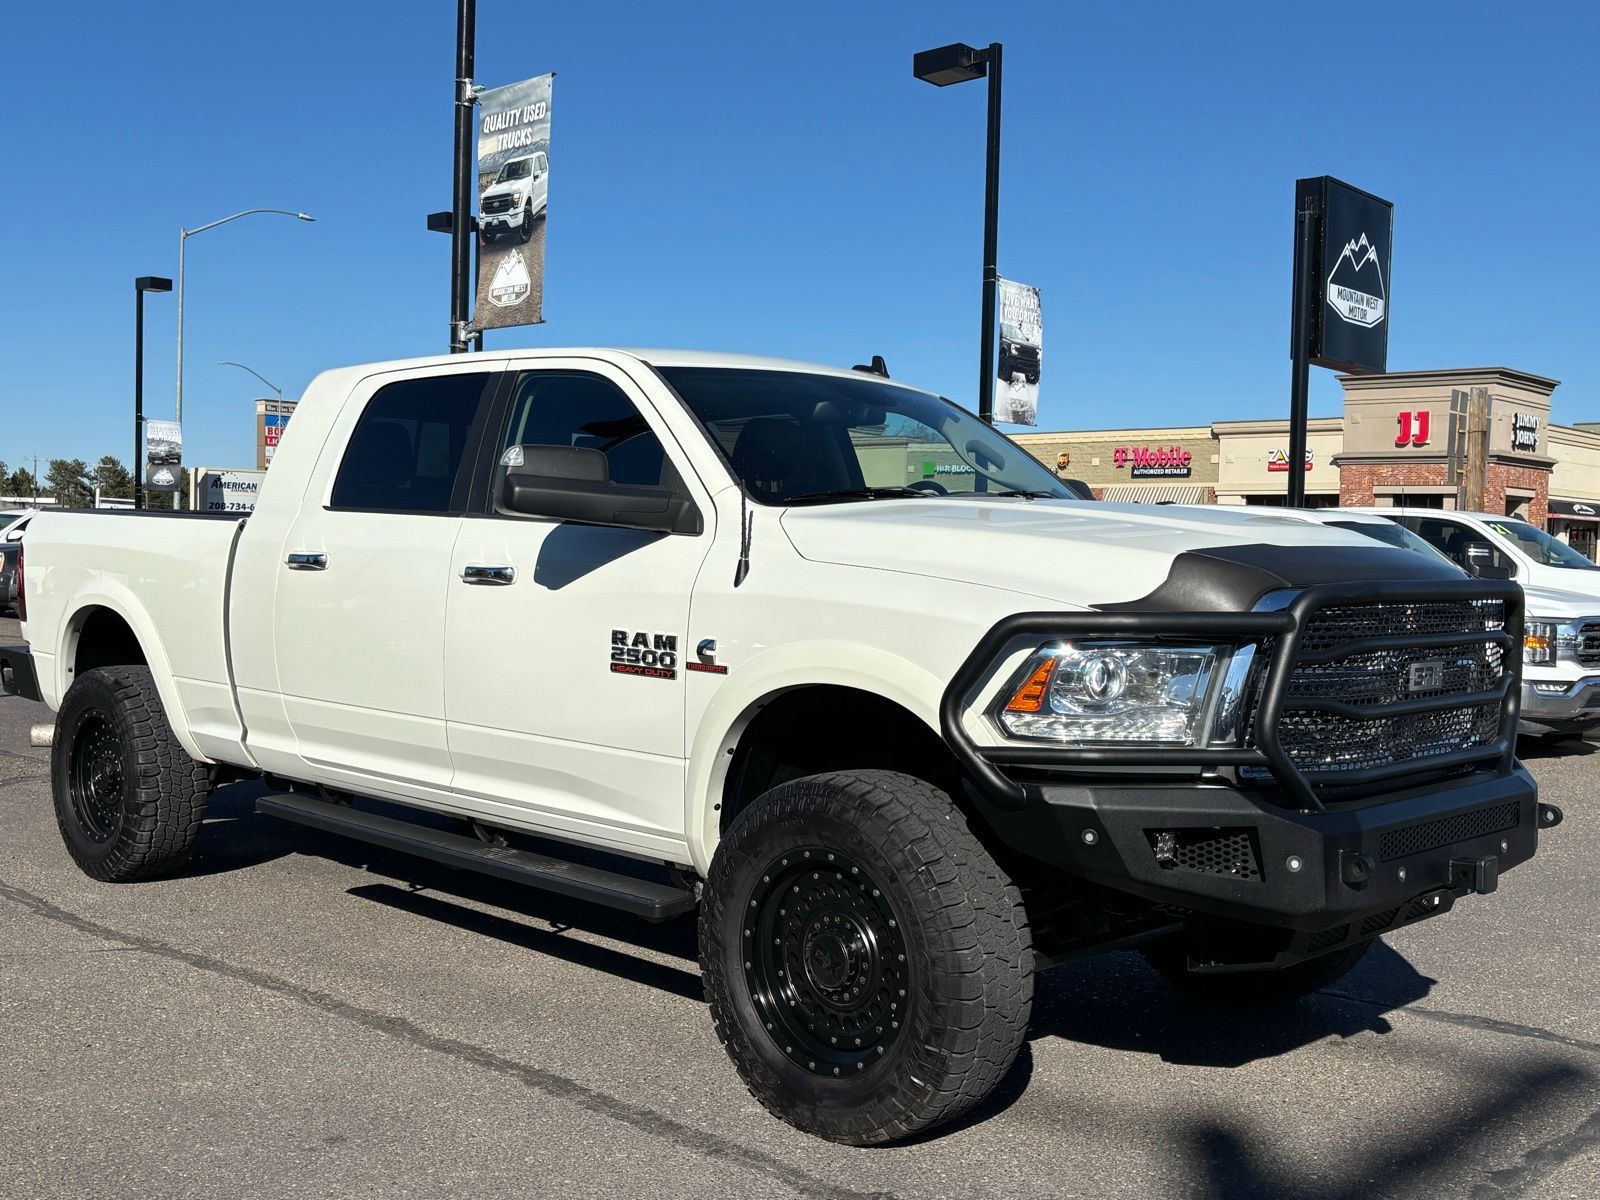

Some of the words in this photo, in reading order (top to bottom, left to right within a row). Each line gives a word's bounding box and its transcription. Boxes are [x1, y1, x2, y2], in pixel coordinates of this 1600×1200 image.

[483, 107, 521, 133] QUALITY
[523, 102, 547, 123] USED
[498, 127, 532, 151] TRUCKS
[1336, 286, 1365, 305] MOUNTAIN
[1365, 295, 1379, 311] WEST
[1348, 305, 1368, 321] MOTOR
[1395, 410, 1431, 444] JJ
[1515, 412, 1541, 429] JIMMY
[1515, 429, 1540, 446] JOHN'S
[1113, 446, 1192, 468] T-Mobile
[1268, 448, 1313, 463] ZAG
[1164, 467, 1188, 475] RETAILER
[611, 629, 679, 652] RAM
[610, 645, 678, 669] 2500
[612, 664, 642, 674] HEAVY
[645, 668, 673, 678] DUTY
